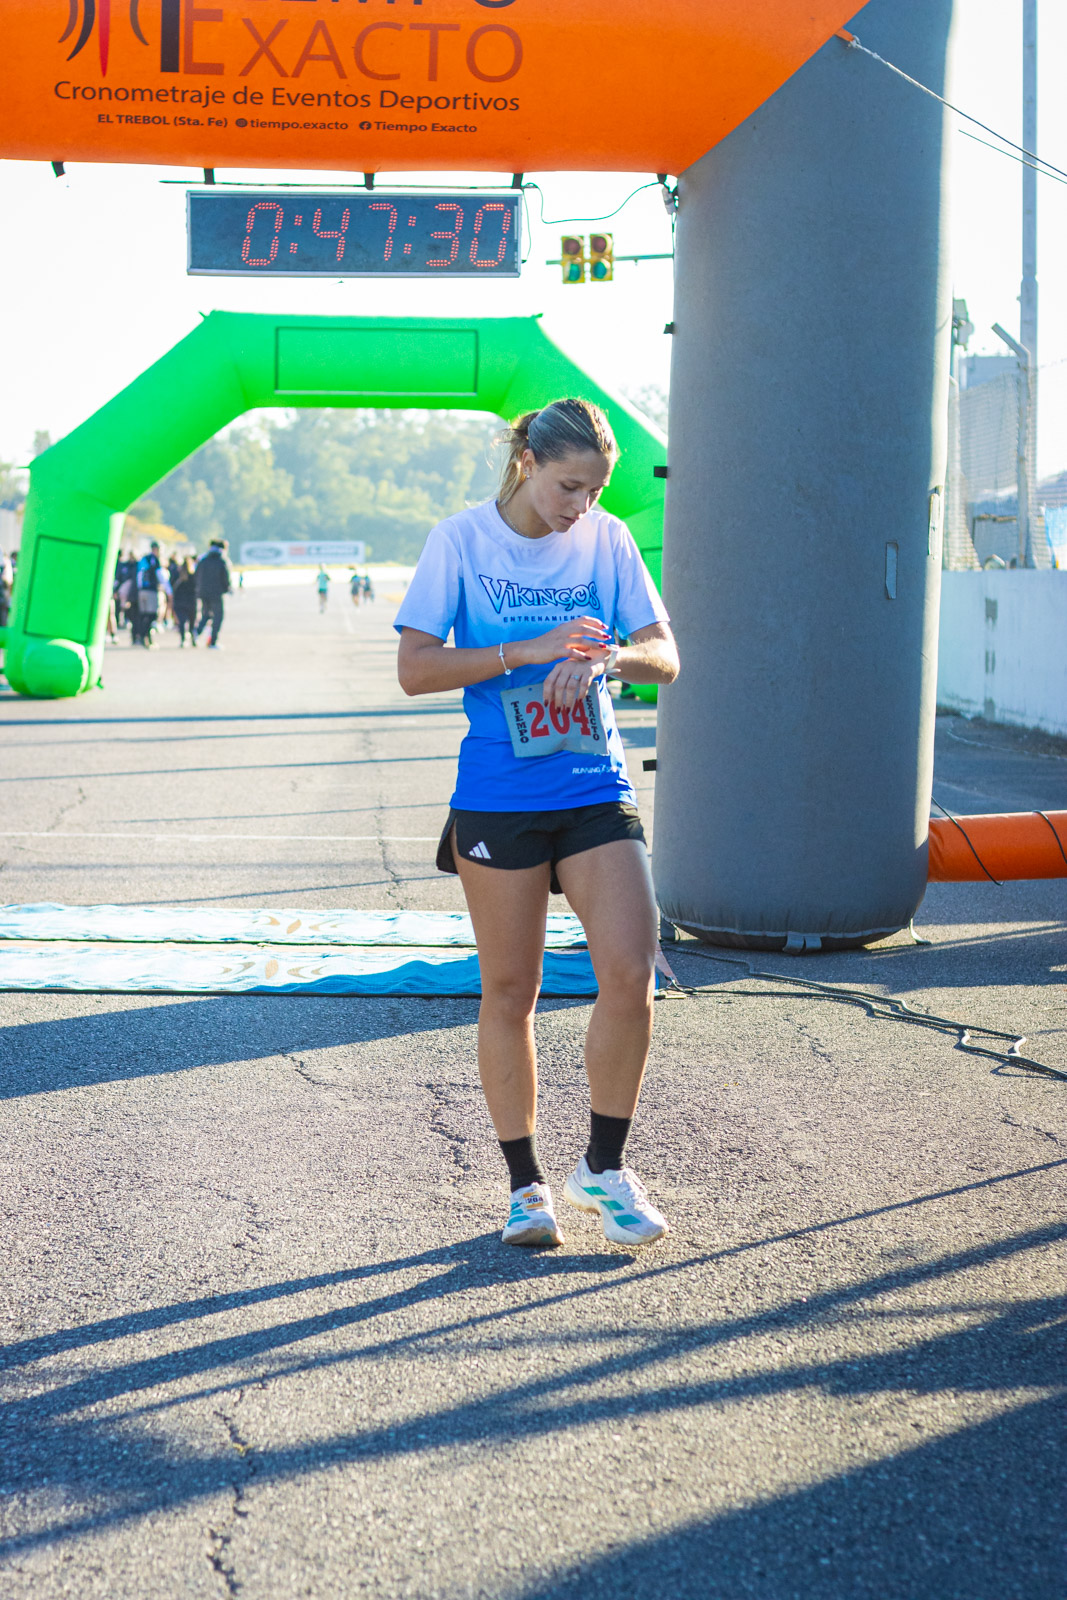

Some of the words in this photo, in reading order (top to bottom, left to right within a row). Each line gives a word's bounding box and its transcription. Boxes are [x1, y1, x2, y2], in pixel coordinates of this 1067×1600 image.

[183, 0, 523, 83] EXACTO
[54, 81, 226, 108] Cronometraje
[233, 86, 264, 105] de
[272, 87, 371, 108] Eventos
[379, 90, 520, 113] Deportivos
[97, 113, 113, 124] EL
[115, 114, 170, 126] TREBOL
[173, 116, 204, 127] (Sta.
[207, 118, 228, 128] Fe)
[250, 119, 349, 131] tiempo.exacto
[374, 121, 428, 133] Tiempo
[431, 123, 478, 133] Exacto
[241, 202, 512, 267] 0:47:30
[511, 701, 529, 743] TIEMPO
[525, 699, 592, 738] 204
[585, 695, 600, 741] EXACTO
